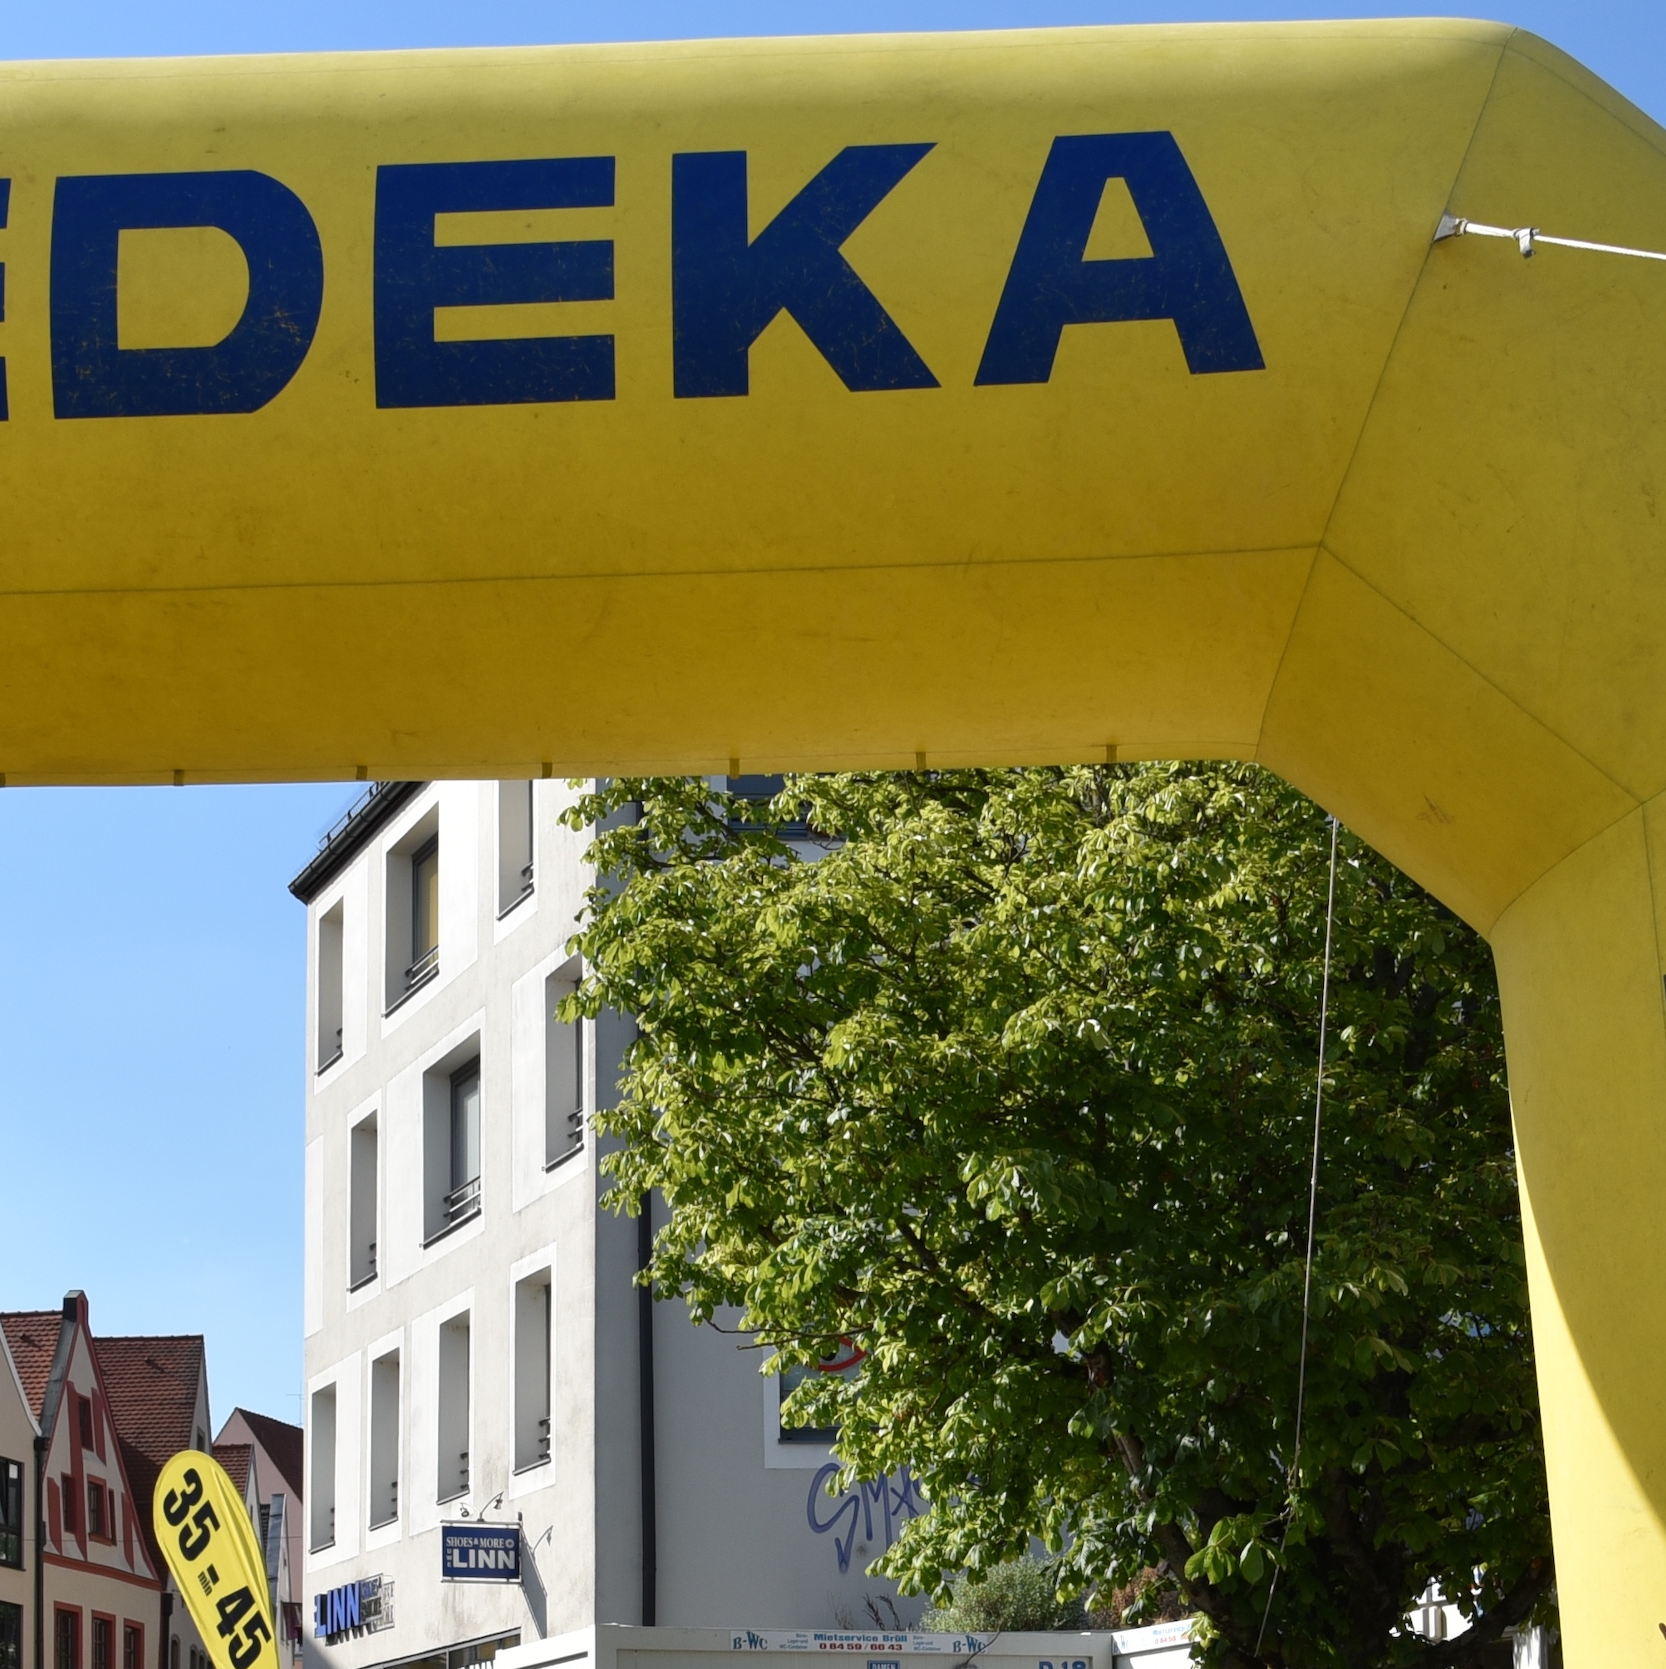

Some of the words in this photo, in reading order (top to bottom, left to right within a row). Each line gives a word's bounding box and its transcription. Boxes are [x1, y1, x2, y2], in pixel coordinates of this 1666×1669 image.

[162, 1468, 221, 1561] 35
[446, 1537, 473, 1548] SHOES
[480, 1538, 504, 1549] MORE
[453, 1549, 515, 1569] LINN
[197, 1572, 213, 1595] min
[316, 1580, 360, 1638] LINN
[814, 1633, 878, 1642] Mietservice
[883, 1634, 908, 1642] Brüll
